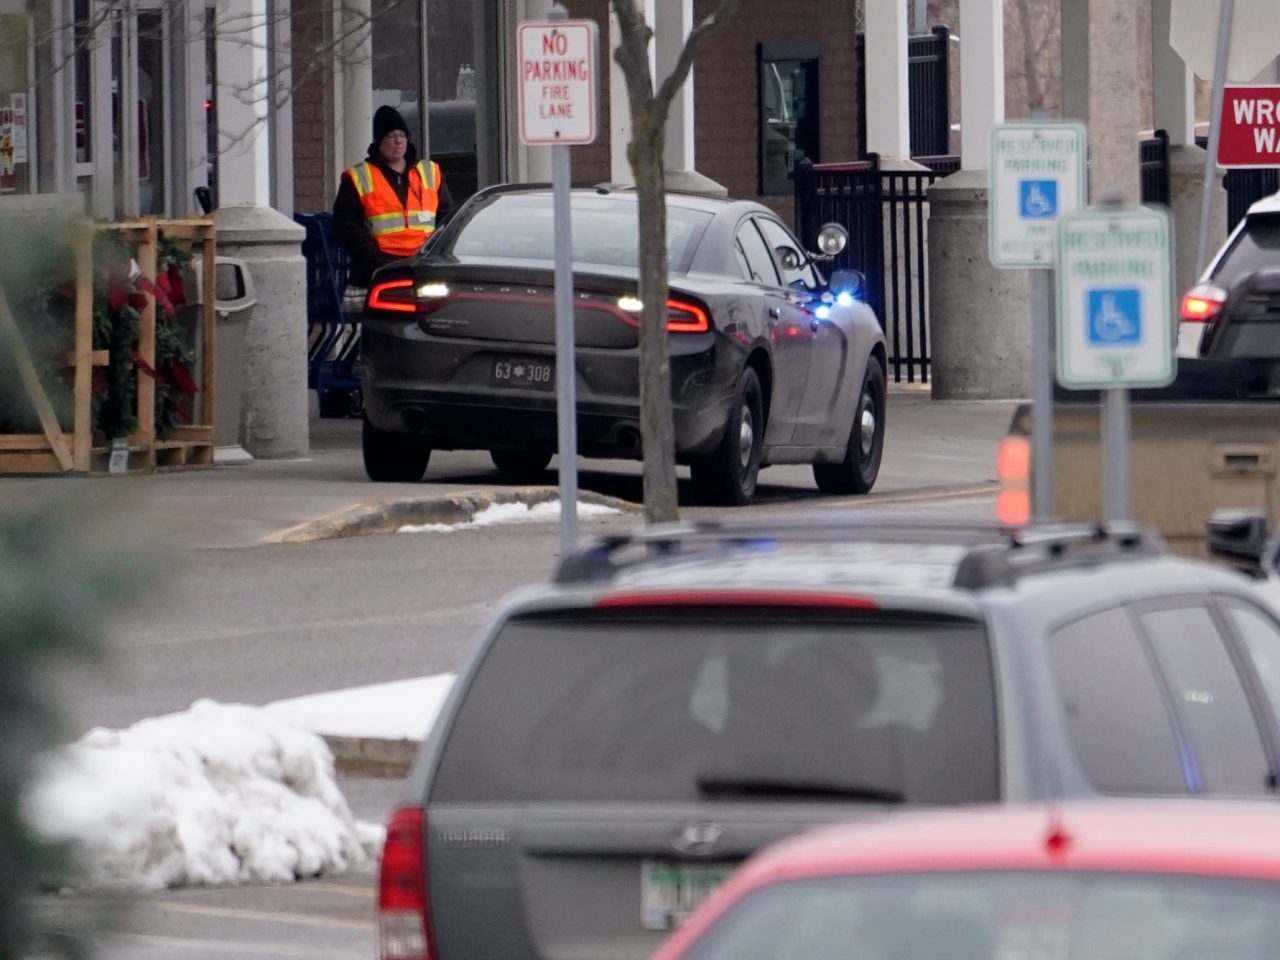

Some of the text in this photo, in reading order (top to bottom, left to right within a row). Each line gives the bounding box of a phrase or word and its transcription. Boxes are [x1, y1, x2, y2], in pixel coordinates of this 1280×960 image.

[543, 34, 568, 55] NO
[524, 61, 588, 81] PARKING
[542, 86, 570, 100] FIRE
[540, 105, 574, 119] LANE
[495, 363, 550, 382] 63 308
